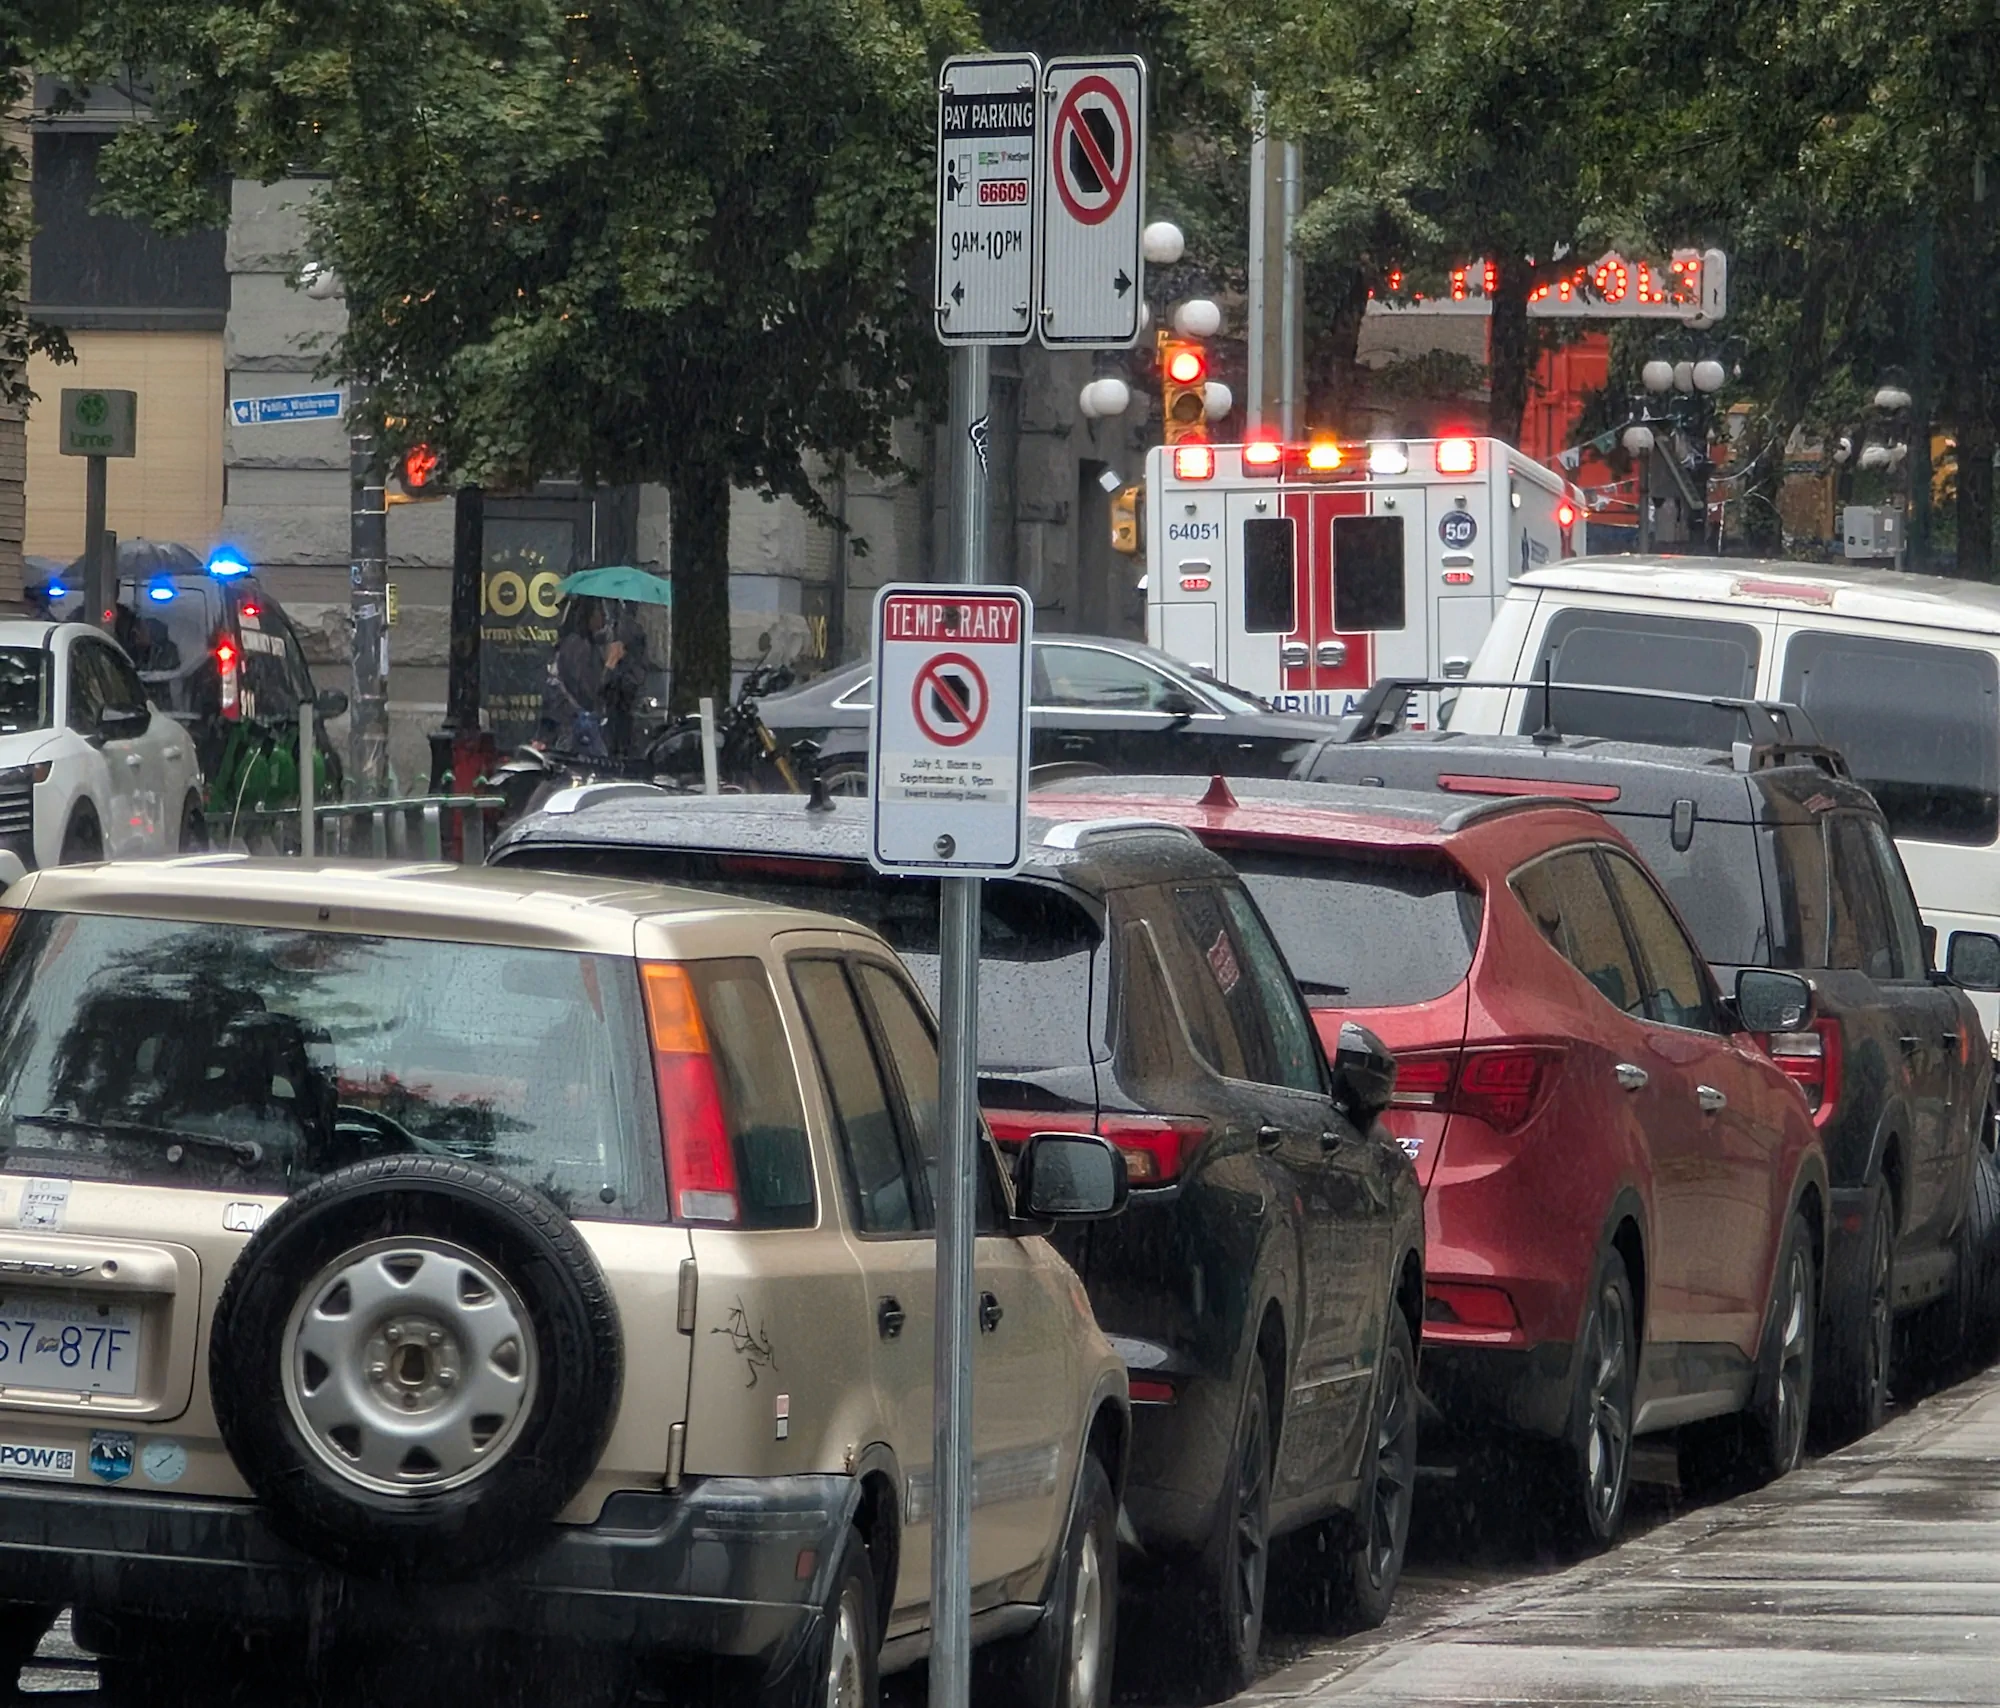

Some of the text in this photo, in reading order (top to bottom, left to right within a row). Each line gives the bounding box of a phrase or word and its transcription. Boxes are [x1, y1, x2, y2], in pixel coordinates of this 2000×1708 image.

[944, 102, 1032, 130] PAY PARKING
[980, 182, 1026, 202] 66609
[1169, 523, 1219, 540] 64051
[890, 603, 1013, 640] TEMPRARY
[900, 773, 955, 785] September
[60, 1326, 131, 1371] 87F
[1, 1446, 56, 1468] POW
